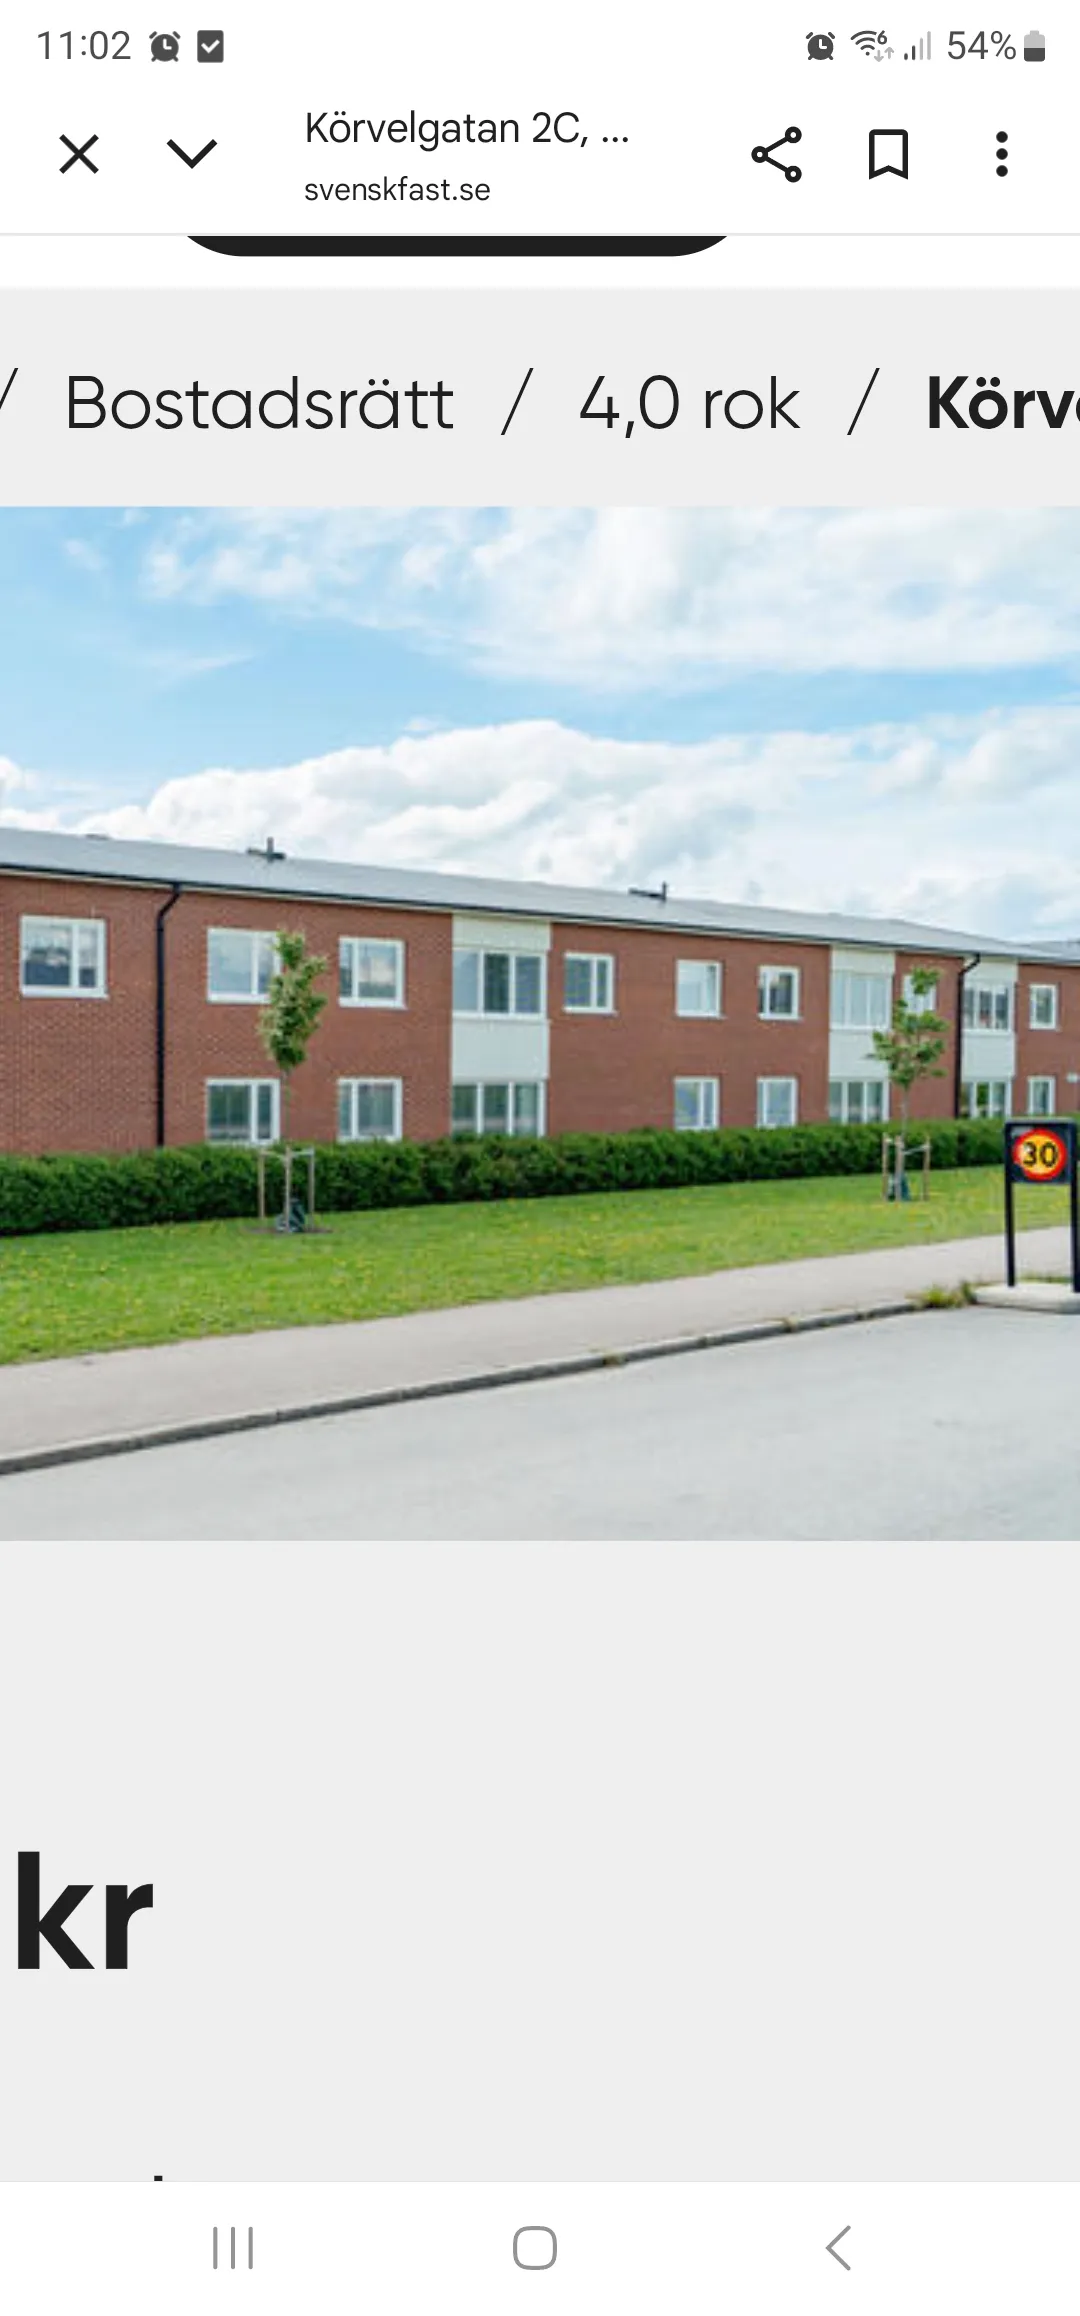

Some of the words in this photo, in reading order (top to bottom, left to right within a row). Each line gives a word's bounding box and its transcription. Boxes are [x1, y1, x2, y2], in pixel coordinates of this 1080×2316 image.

[37, 30, 132, 60] 11:02
[947, 30, 1017, 60] 54%
[305, 110, 521, 153] Körvelgatan
[532, 111, 589, 148] 2C,
[304, 175, 491, 202] svenskfast.se
[67, 375, 455, 430] Bostadsrätt
[579, 374, 680, 439] 4,0
[705, 375, 801, 430] rok
[928, 375, 1080, 430] Körv
[1023, 1141, 1058, 1168] 30
[17, 1850, 154, 1970] kr
